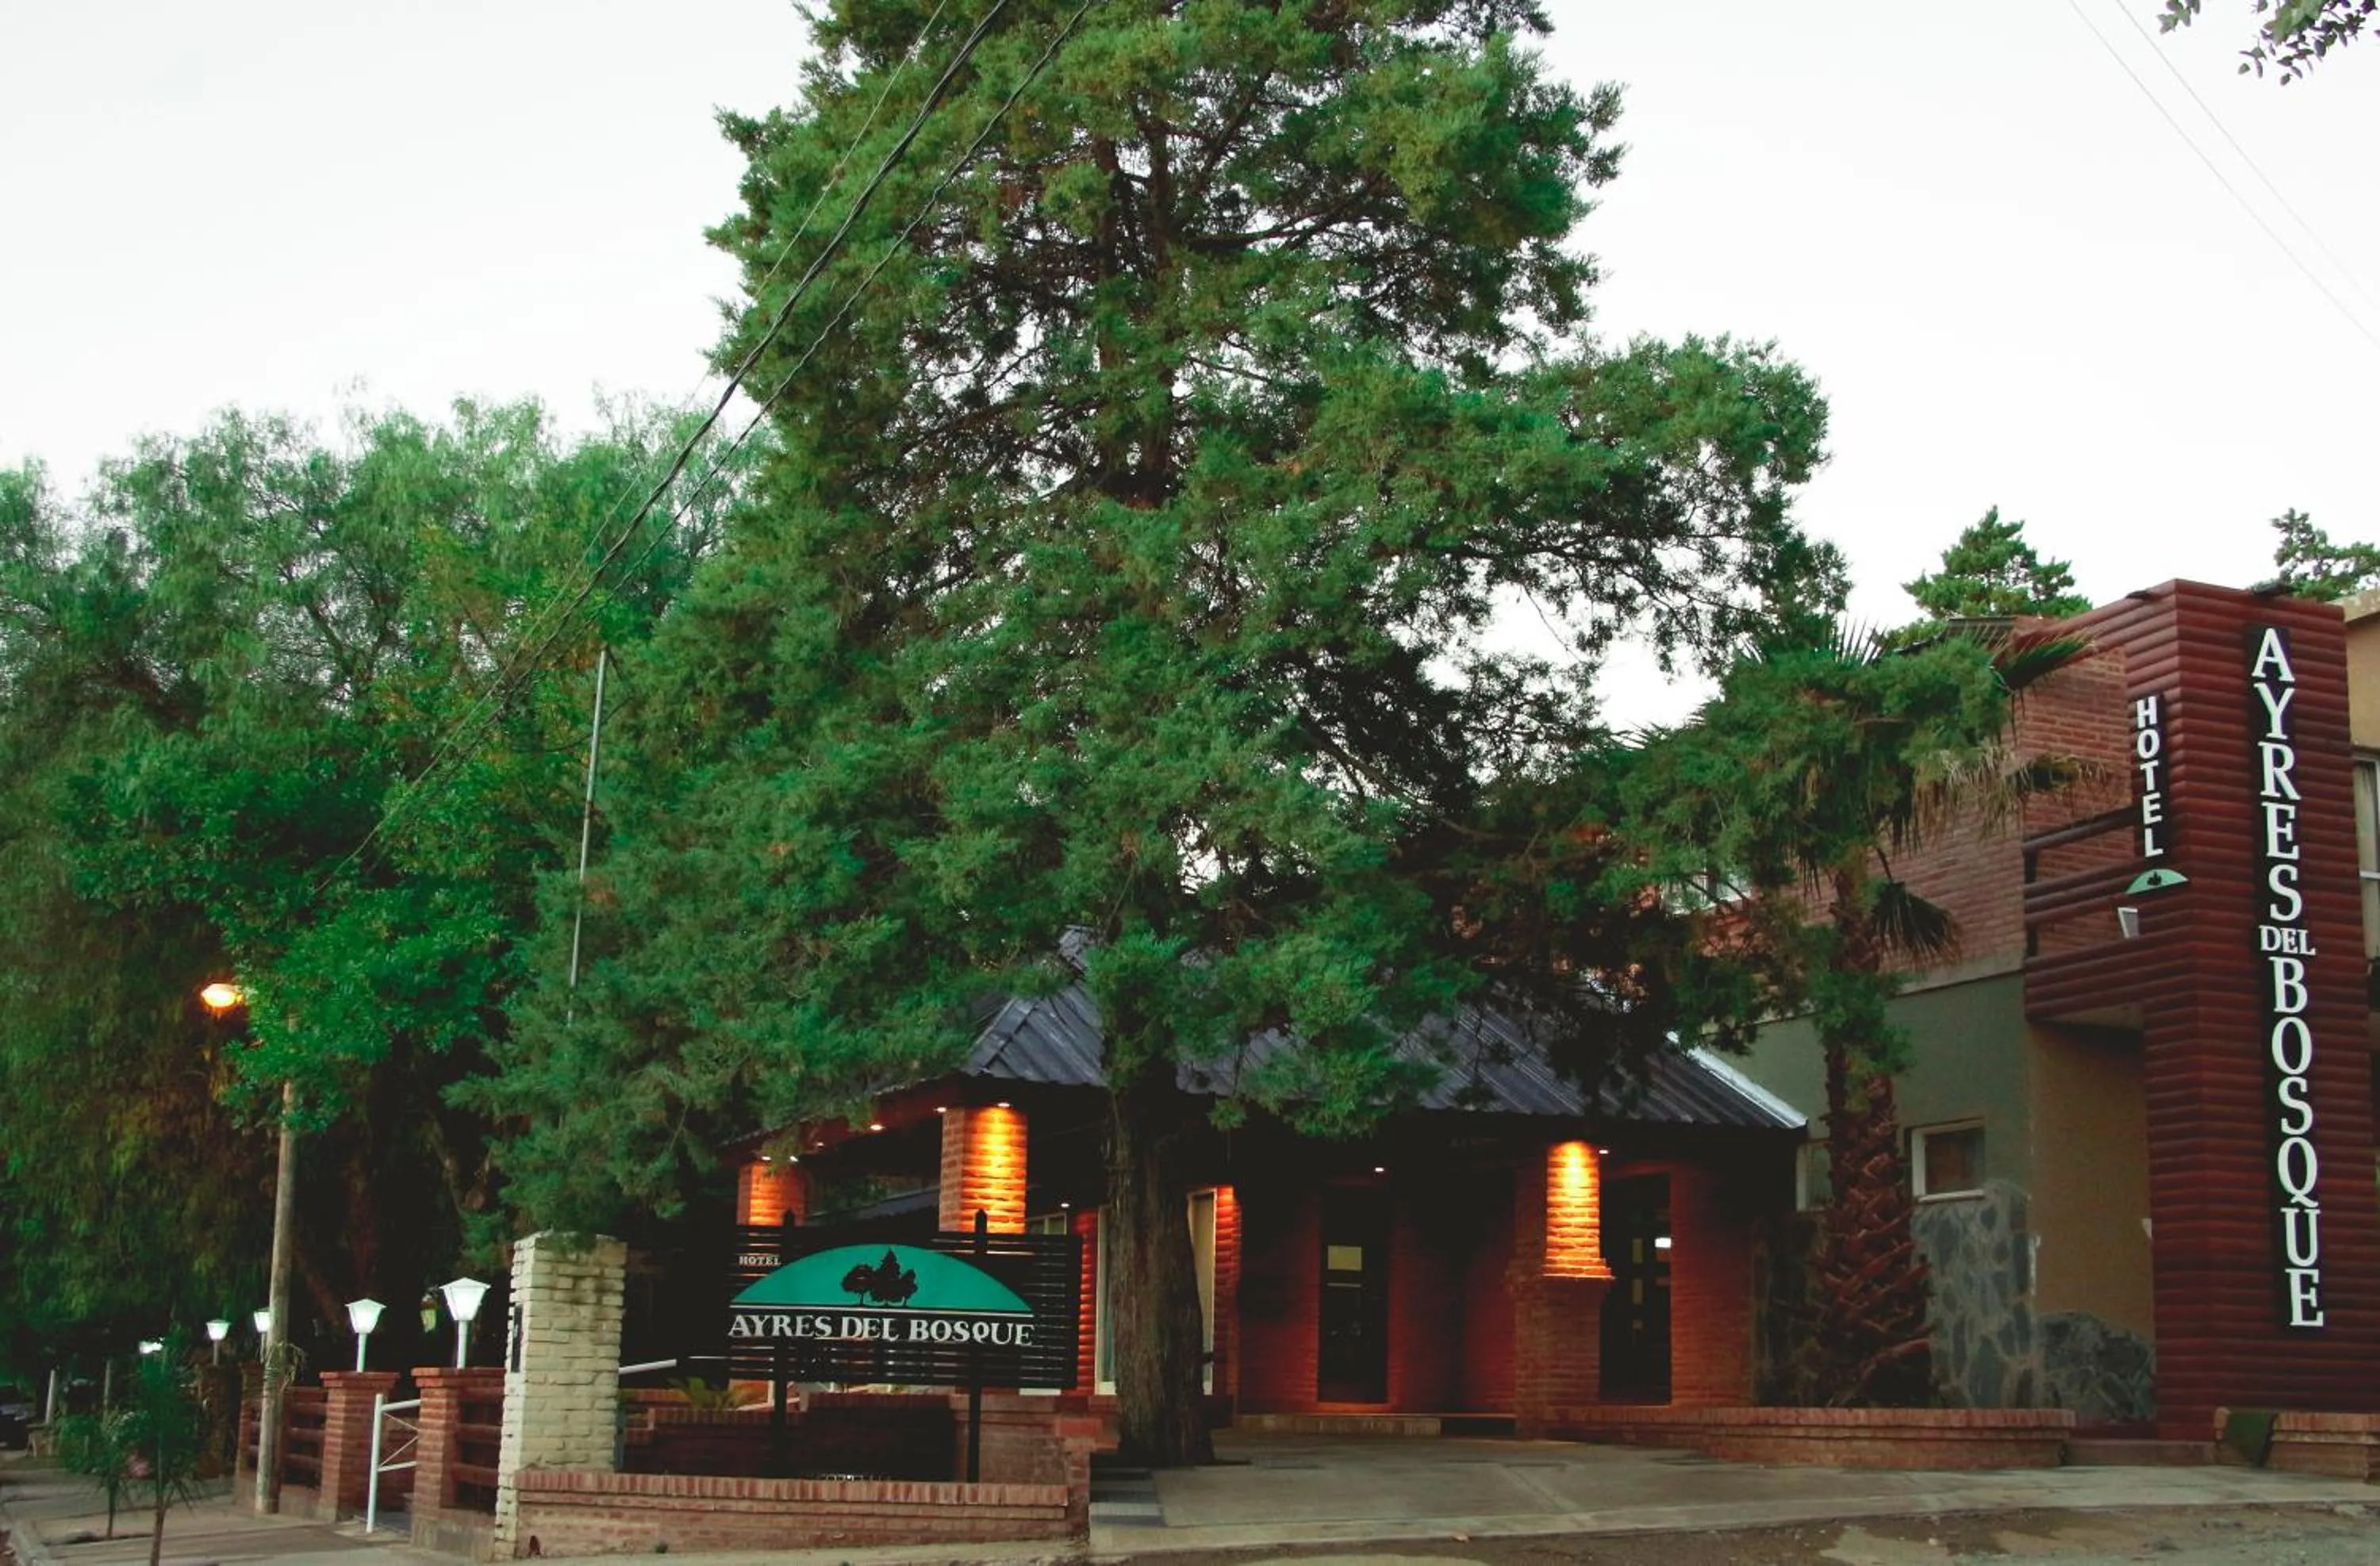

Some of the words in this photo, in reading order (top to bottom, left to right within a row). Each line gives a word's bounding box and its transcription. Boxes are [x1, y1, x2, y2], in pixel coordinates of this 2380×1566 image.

[2136, 695, 2163, 858] HOTEL
[2251, 628, 2304, 921] AYRES
[2259, 924, 2317, 956] DEL
[2267, 956, 2324, 1328] BOSQUE
[739, 1255, 781, 1266] HOTEL
[727, 1314, 833, 1338] AYRES
[840, 1315, 900, 1342] DEL
[908, 1318, 1035, 1346] BOSQUE
